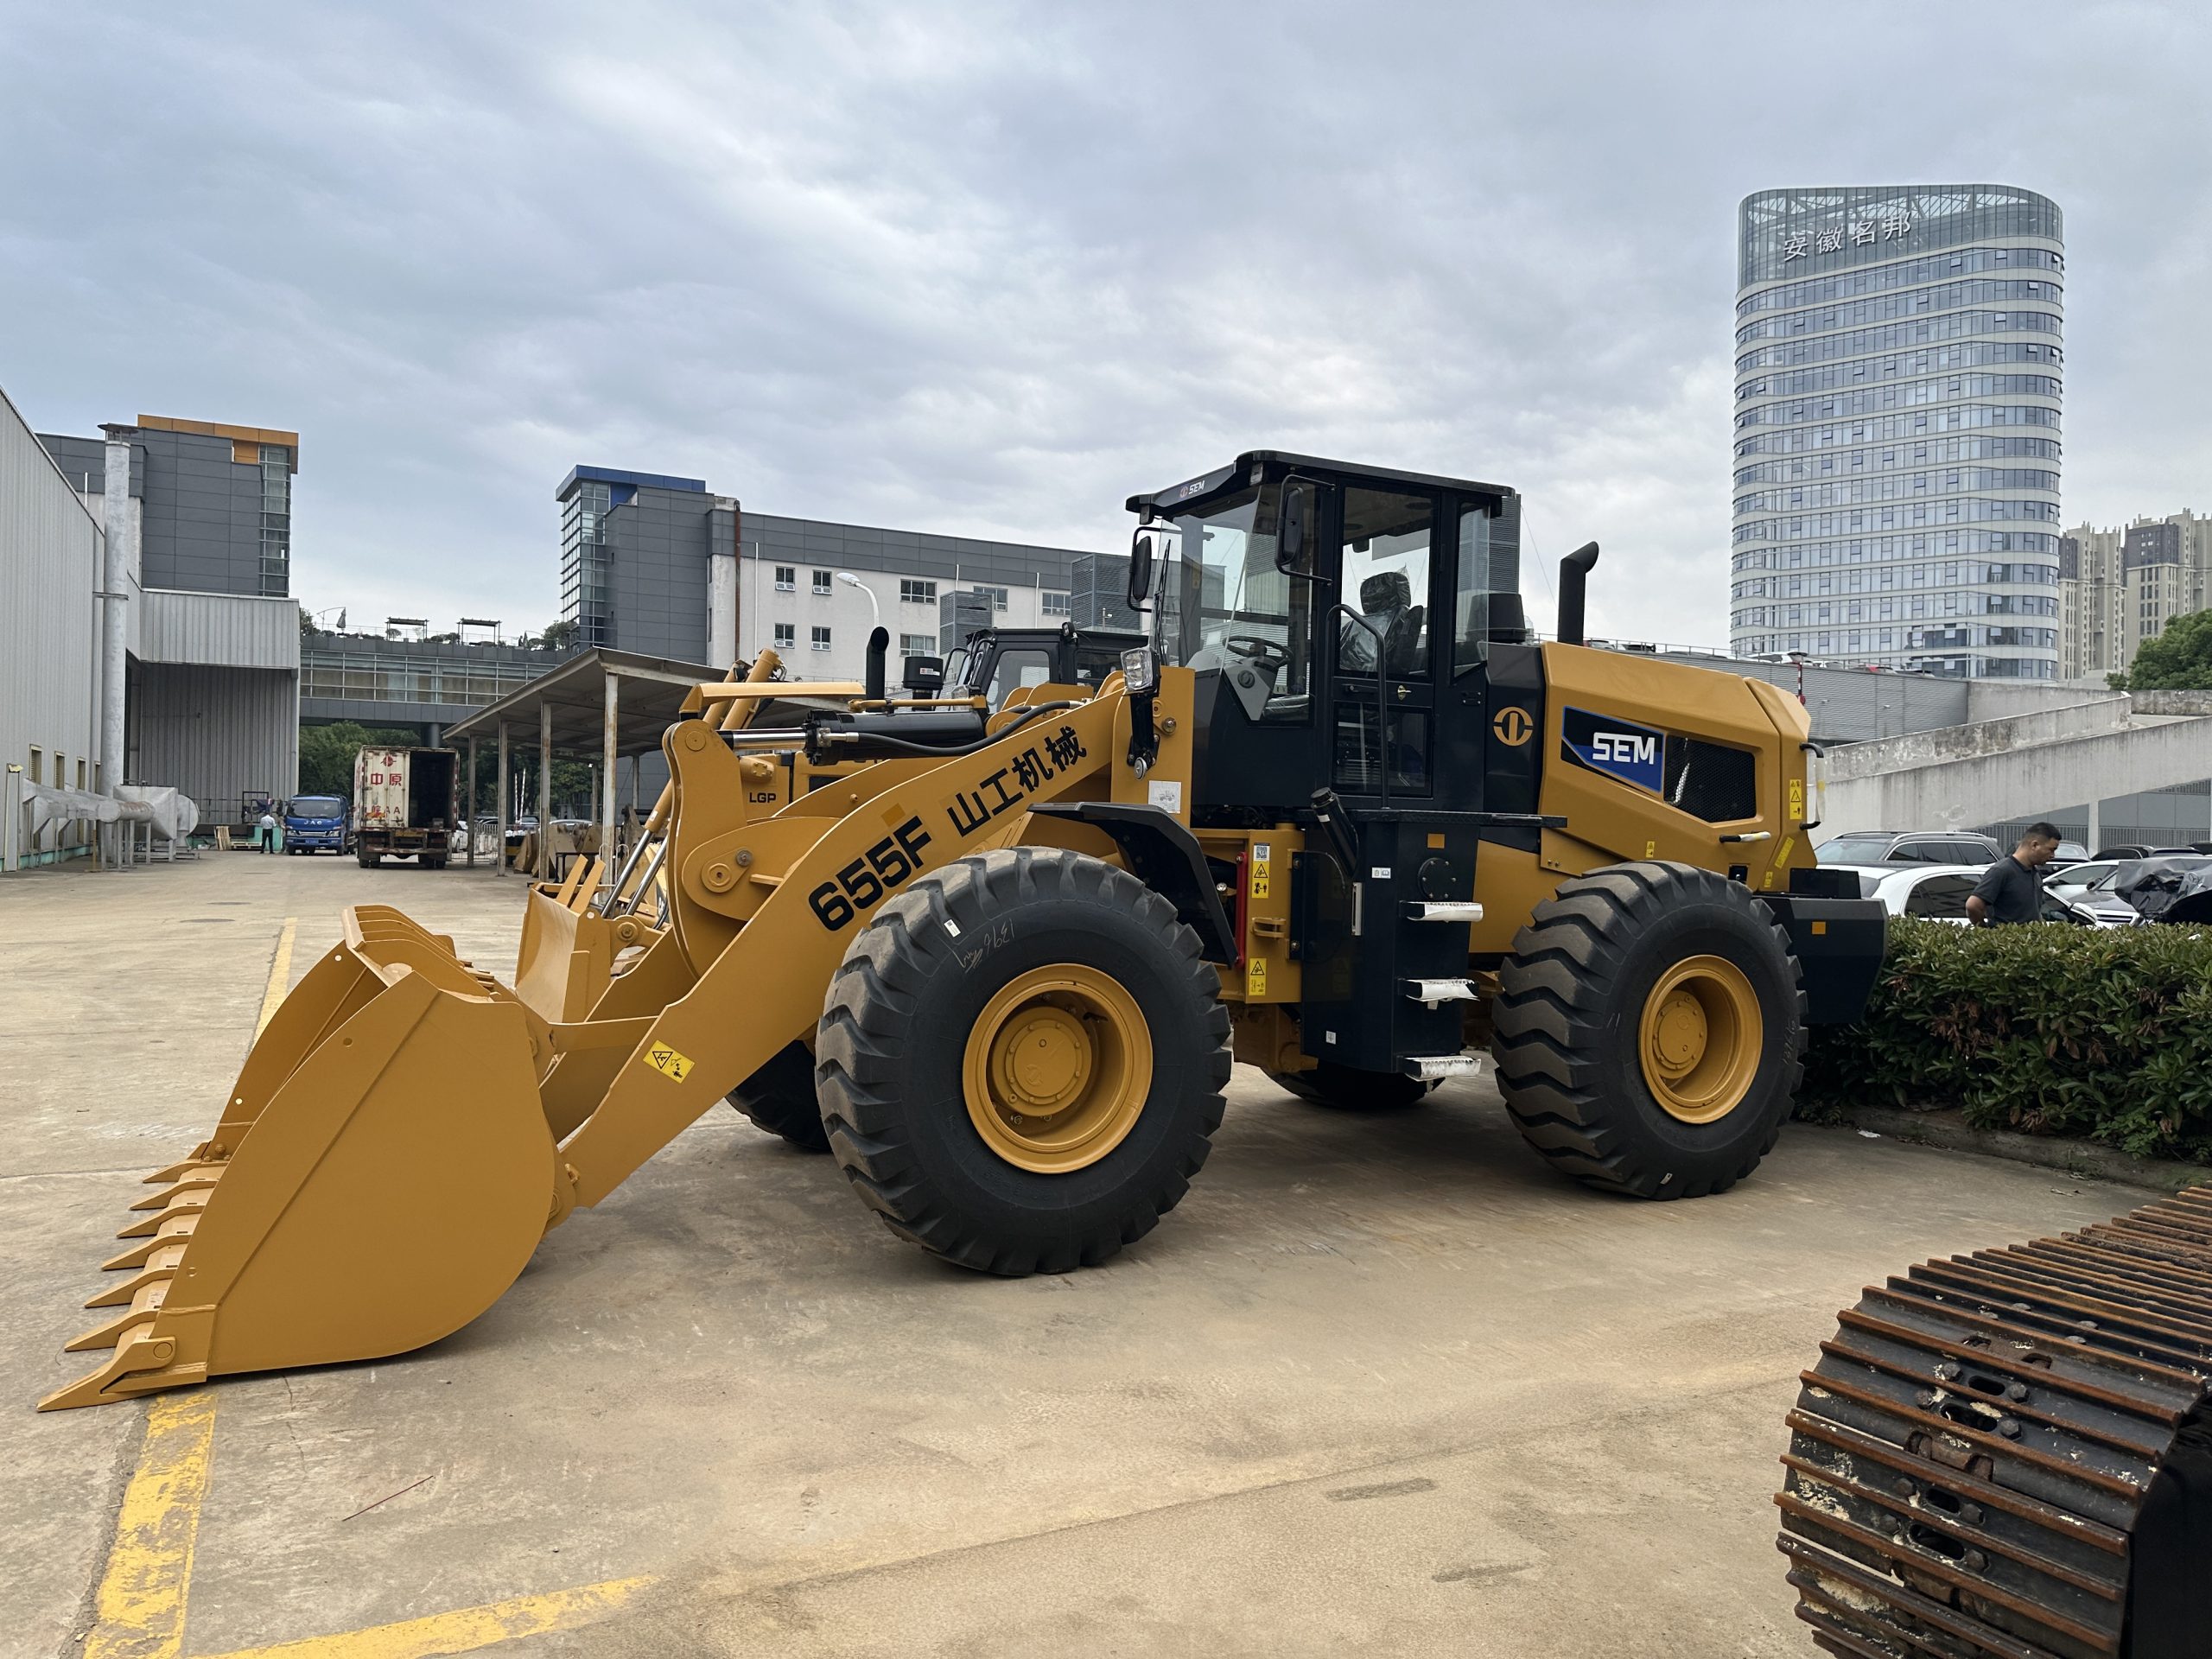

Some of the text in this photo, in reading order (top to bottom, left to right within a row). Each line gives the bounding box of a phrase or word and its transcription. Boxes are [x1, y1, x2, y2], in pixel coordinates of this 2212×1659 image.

[1783, 211, 1912, 262] 安徽名邦
[1188, 480, 1205, 495] SEM
[1592, 731, 1656, 766] SEM
[370, 772, 403, 786] 中原
[749, 791, 777, 804] LGP
[808, 725, 1087, 931] 655F 山工机械
